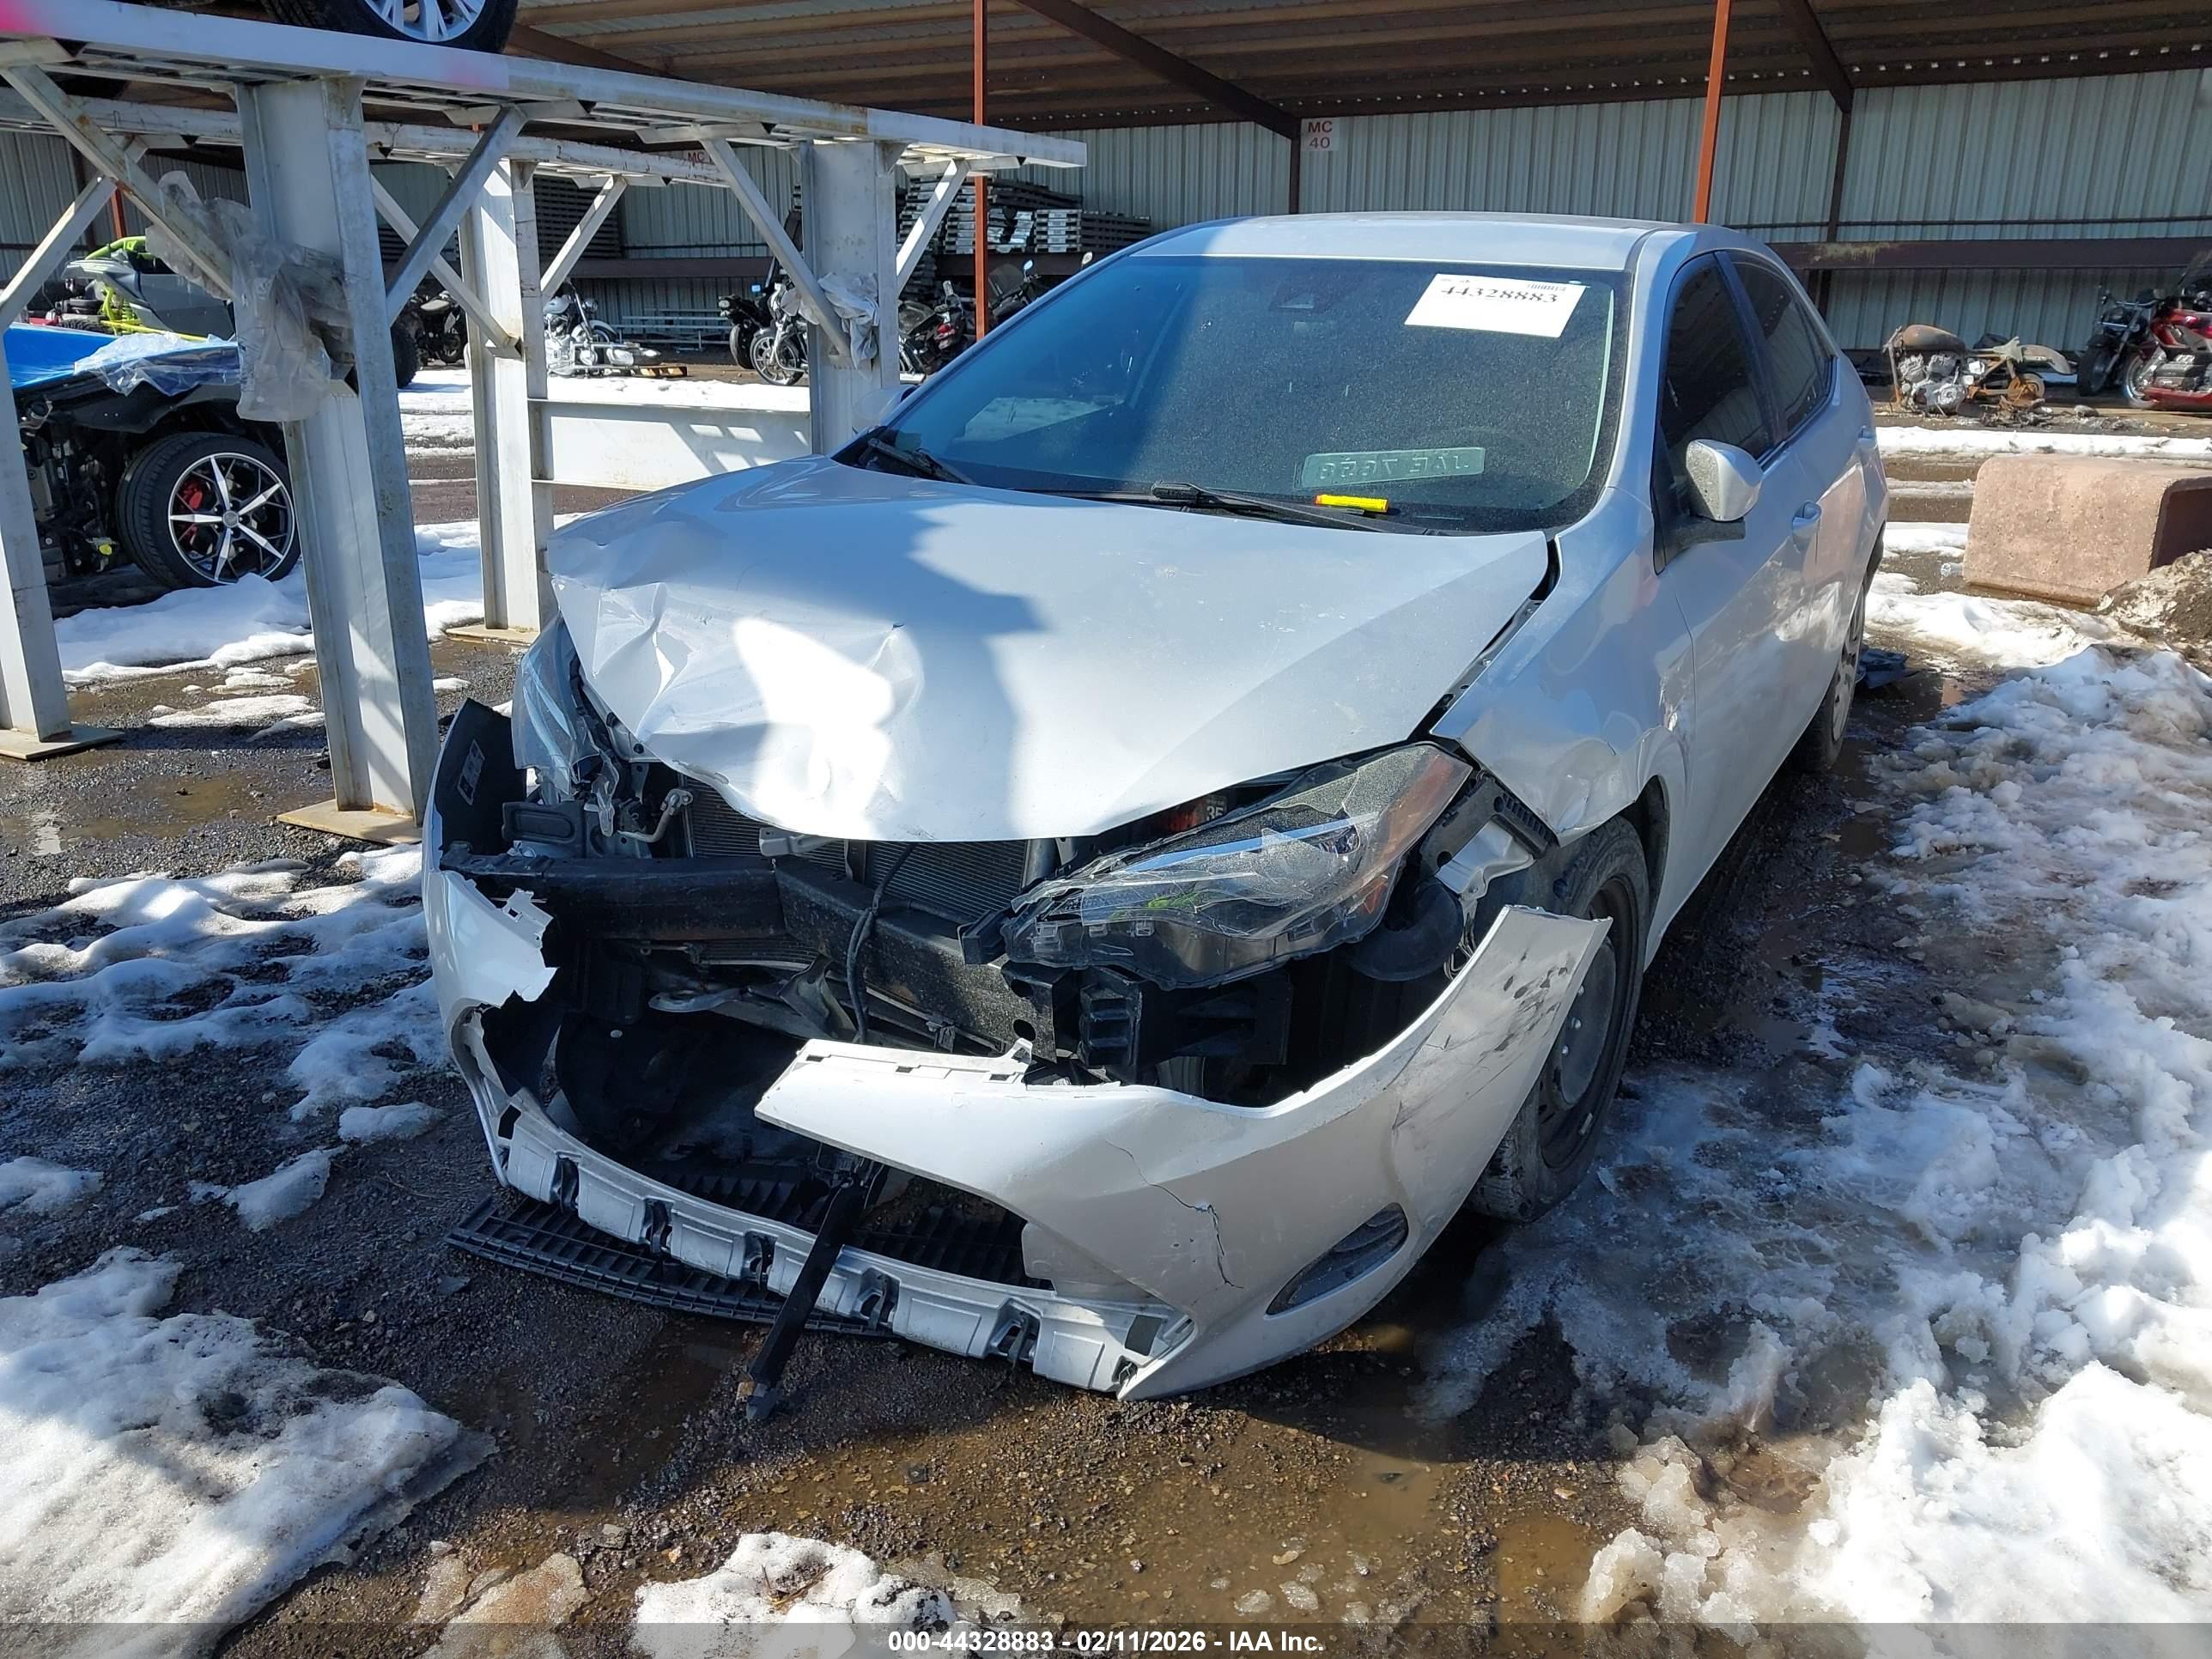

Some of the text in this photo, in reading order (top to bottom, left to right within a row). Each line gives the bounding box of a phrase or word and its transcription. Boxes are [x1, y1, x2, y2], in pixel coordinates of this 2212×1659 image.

[1308, 121, 1333, 133] MC
[1310, 137, 1330, 149] 40
[688, 151, 705, 163] MC
[1441, 285, 1559, 303] 44328883
